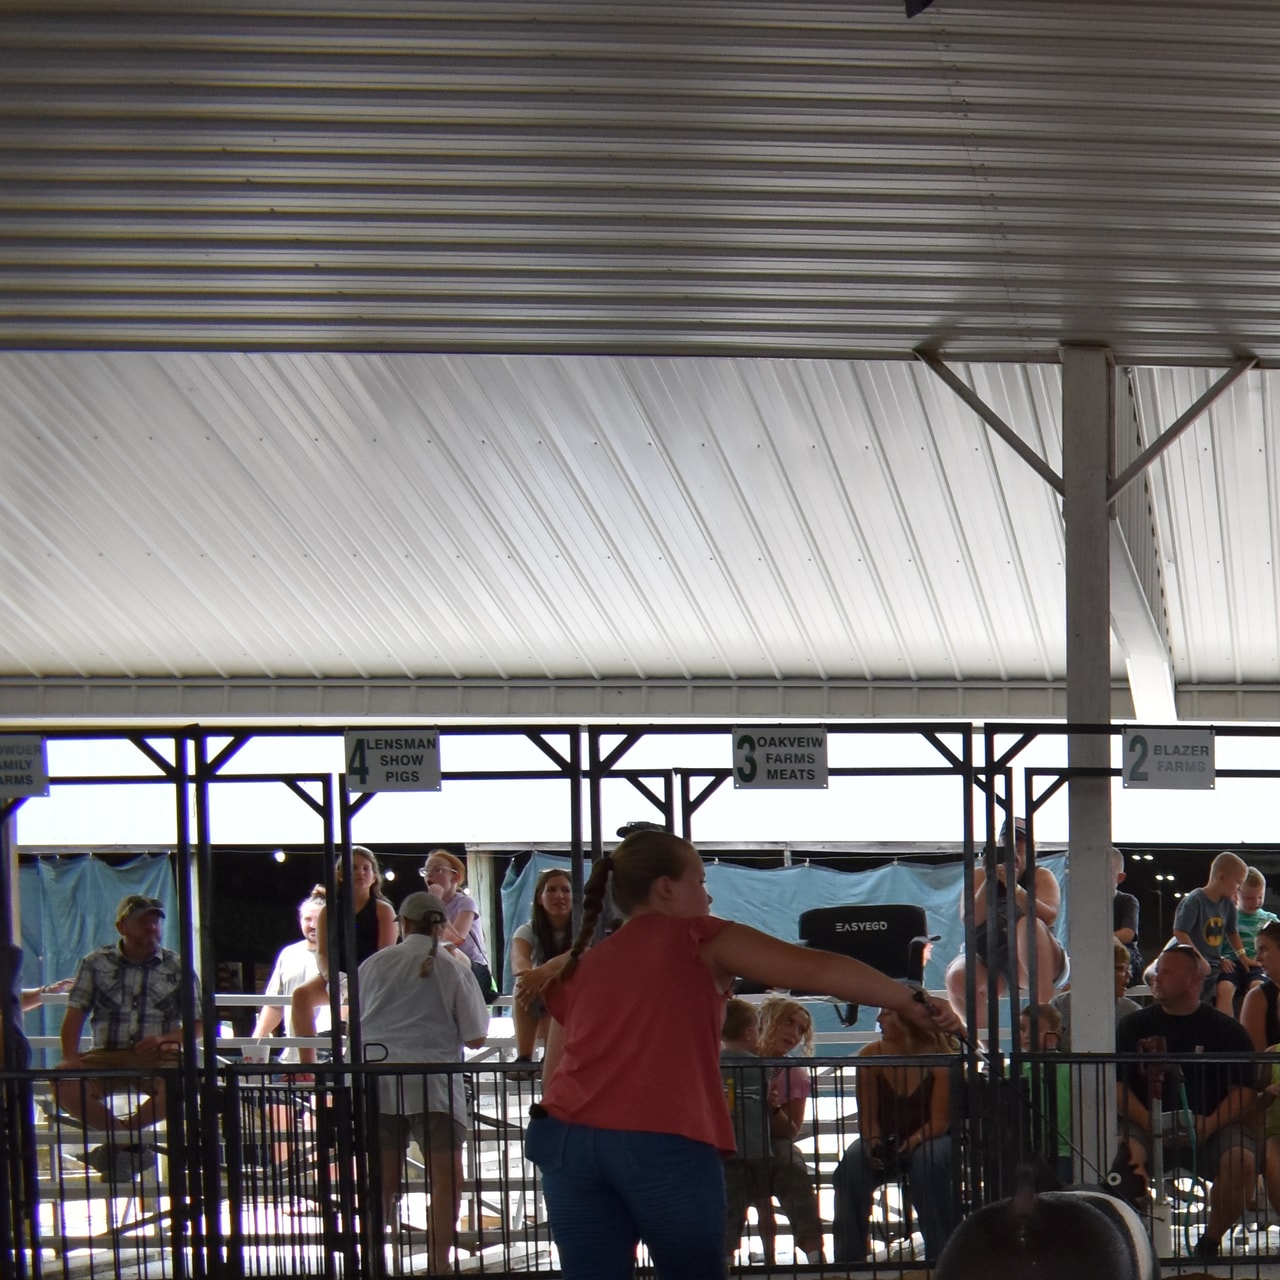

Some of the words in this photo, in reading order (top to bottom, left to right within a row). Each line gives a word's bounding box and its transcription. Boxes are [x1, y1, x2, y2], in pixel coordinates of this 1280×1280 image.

[366, 738, 436, 750] LENSMAN
[757, 736, 823, 748] OAKVEIW
[1153, 744, 1209, 756] BLAZER
[348, 738, 369, 785] 4
[380, 754, 424, 766] SHOW
[736, 734, 757, 783] 3
[765, 752, 816, 764] FARMS
[1128, 734, 1149, 781] 2
[1157, 761, 1206, 772] FARMS
[385, 771, 419, 782] PIGS
[766, 769, 816, 780] MEATS
